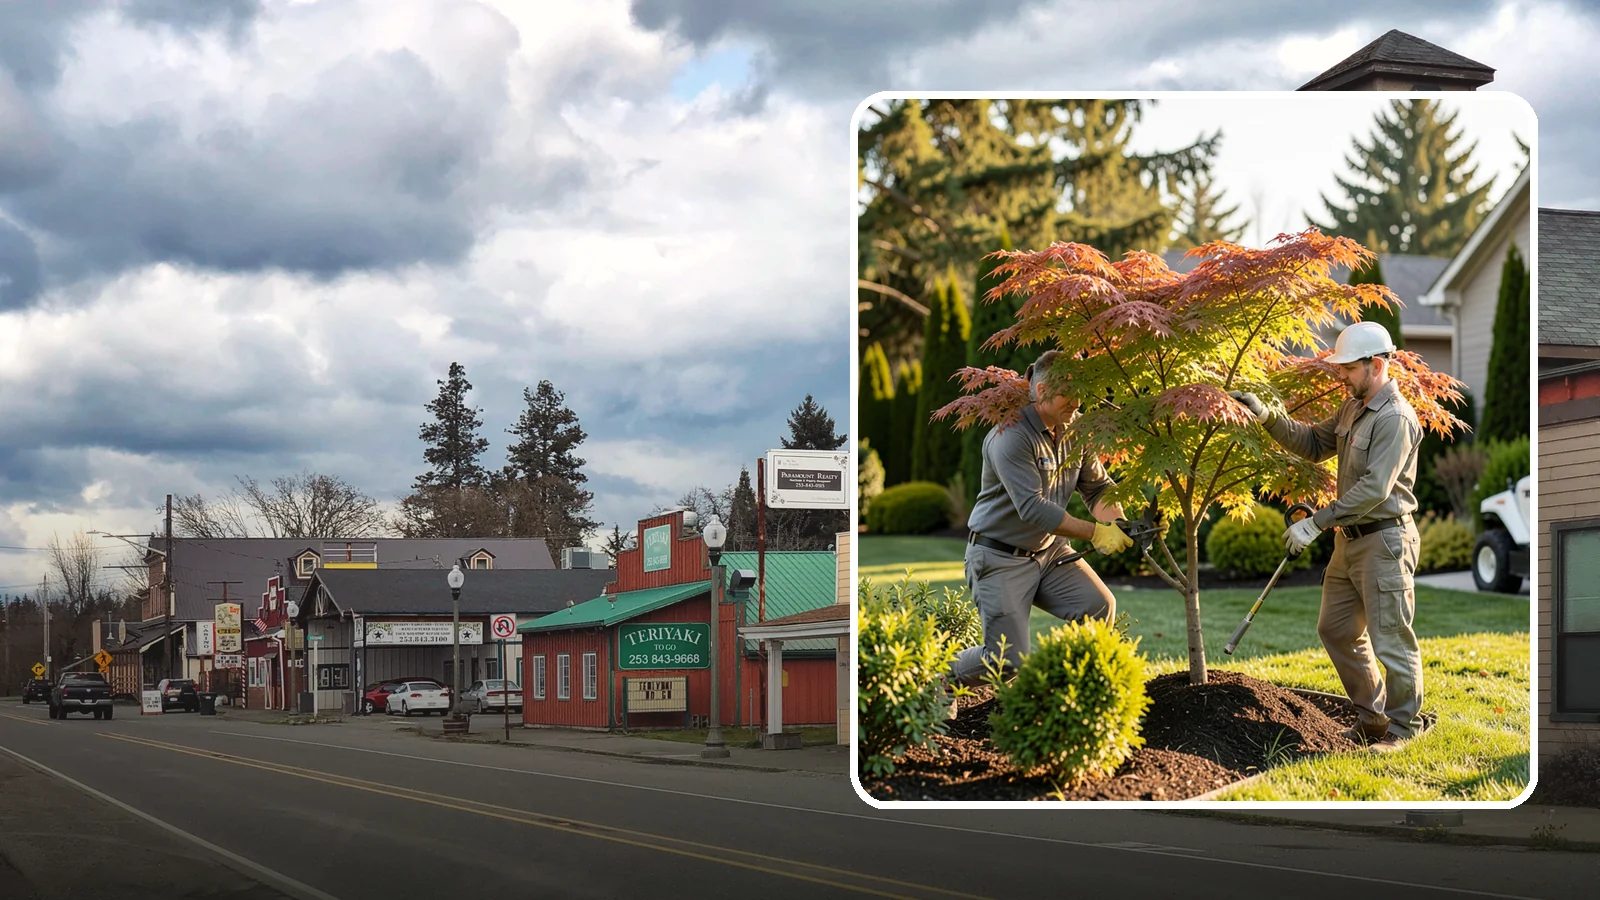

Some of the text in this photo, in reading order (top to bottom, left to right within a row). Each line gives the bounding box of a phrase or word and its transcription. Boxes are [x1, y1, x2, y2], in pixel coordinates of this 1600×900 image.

[781, 471, 839, 480] PARAMOUNT REALTY
[624, 627, 703, 646] TERIYAKI
[628, 653, 700, 665] 253 843-9668
[639, 681, 673, 691] TERIYAKI
